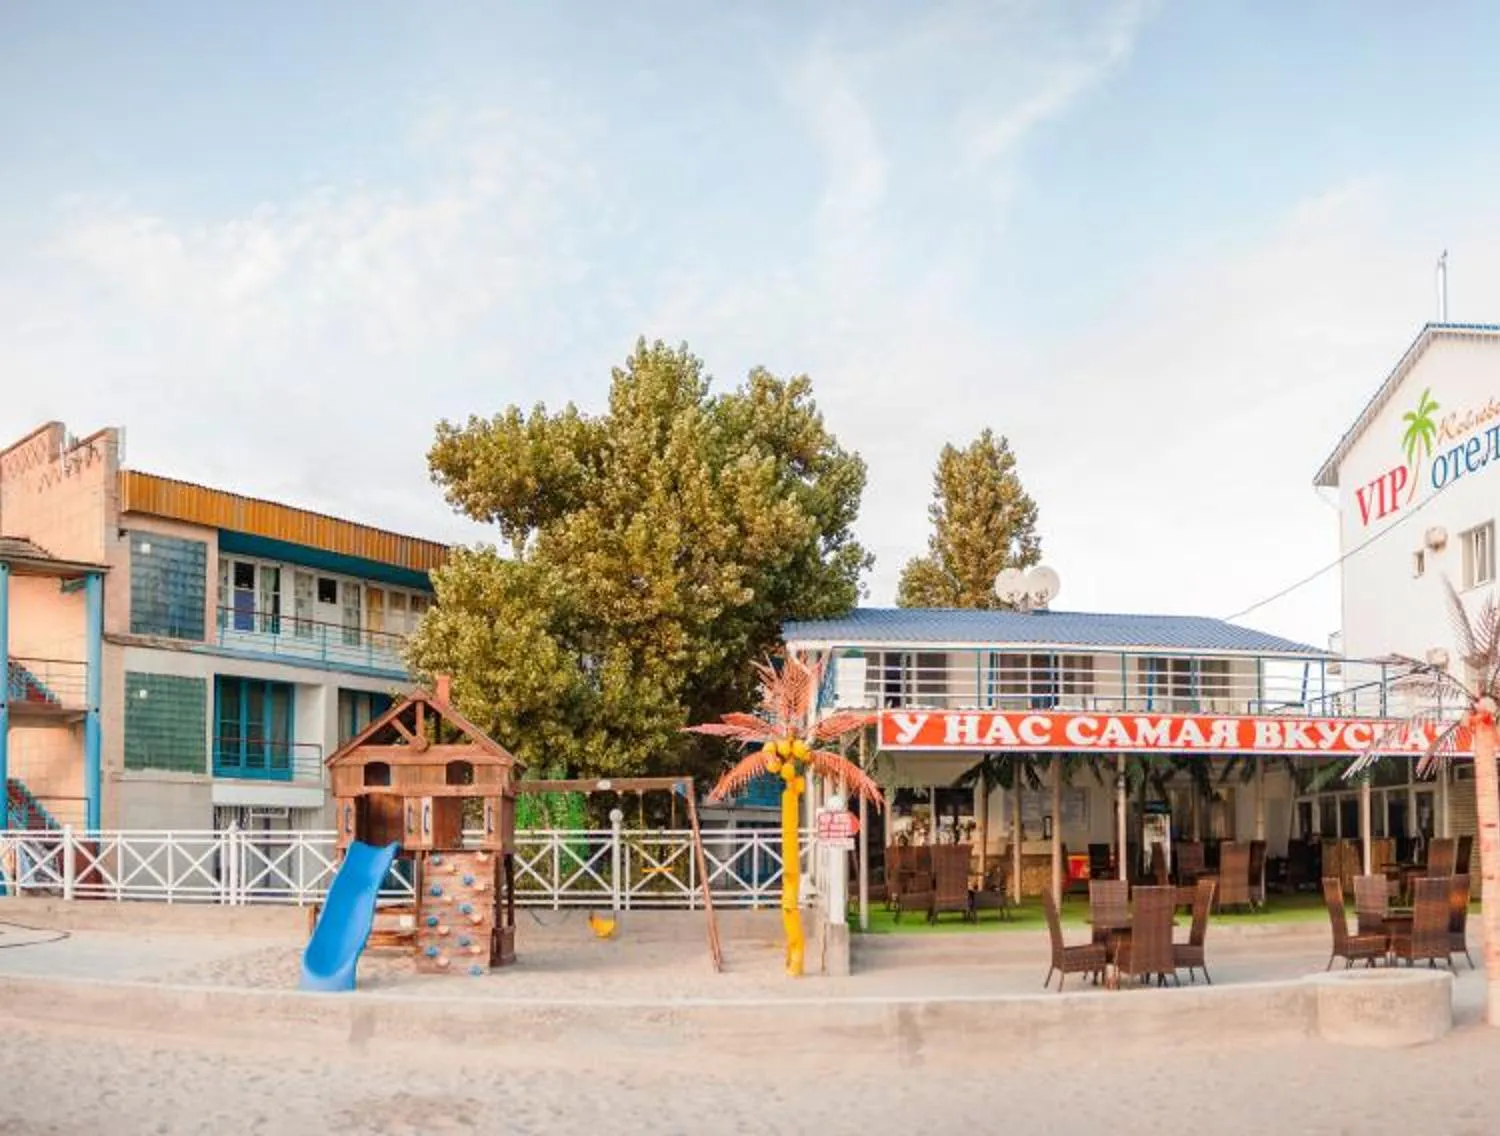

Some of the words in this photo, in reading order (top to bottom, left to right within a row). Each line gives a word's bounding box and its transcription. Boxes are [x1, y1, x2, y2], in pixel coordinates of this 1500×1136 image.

[1355, 464, 1408, 527] VIP
[892, 714, 929, 744] У
[943, 714, 1051, 746] НАС
[1065, 716, 1240, 748] САМАЯ
